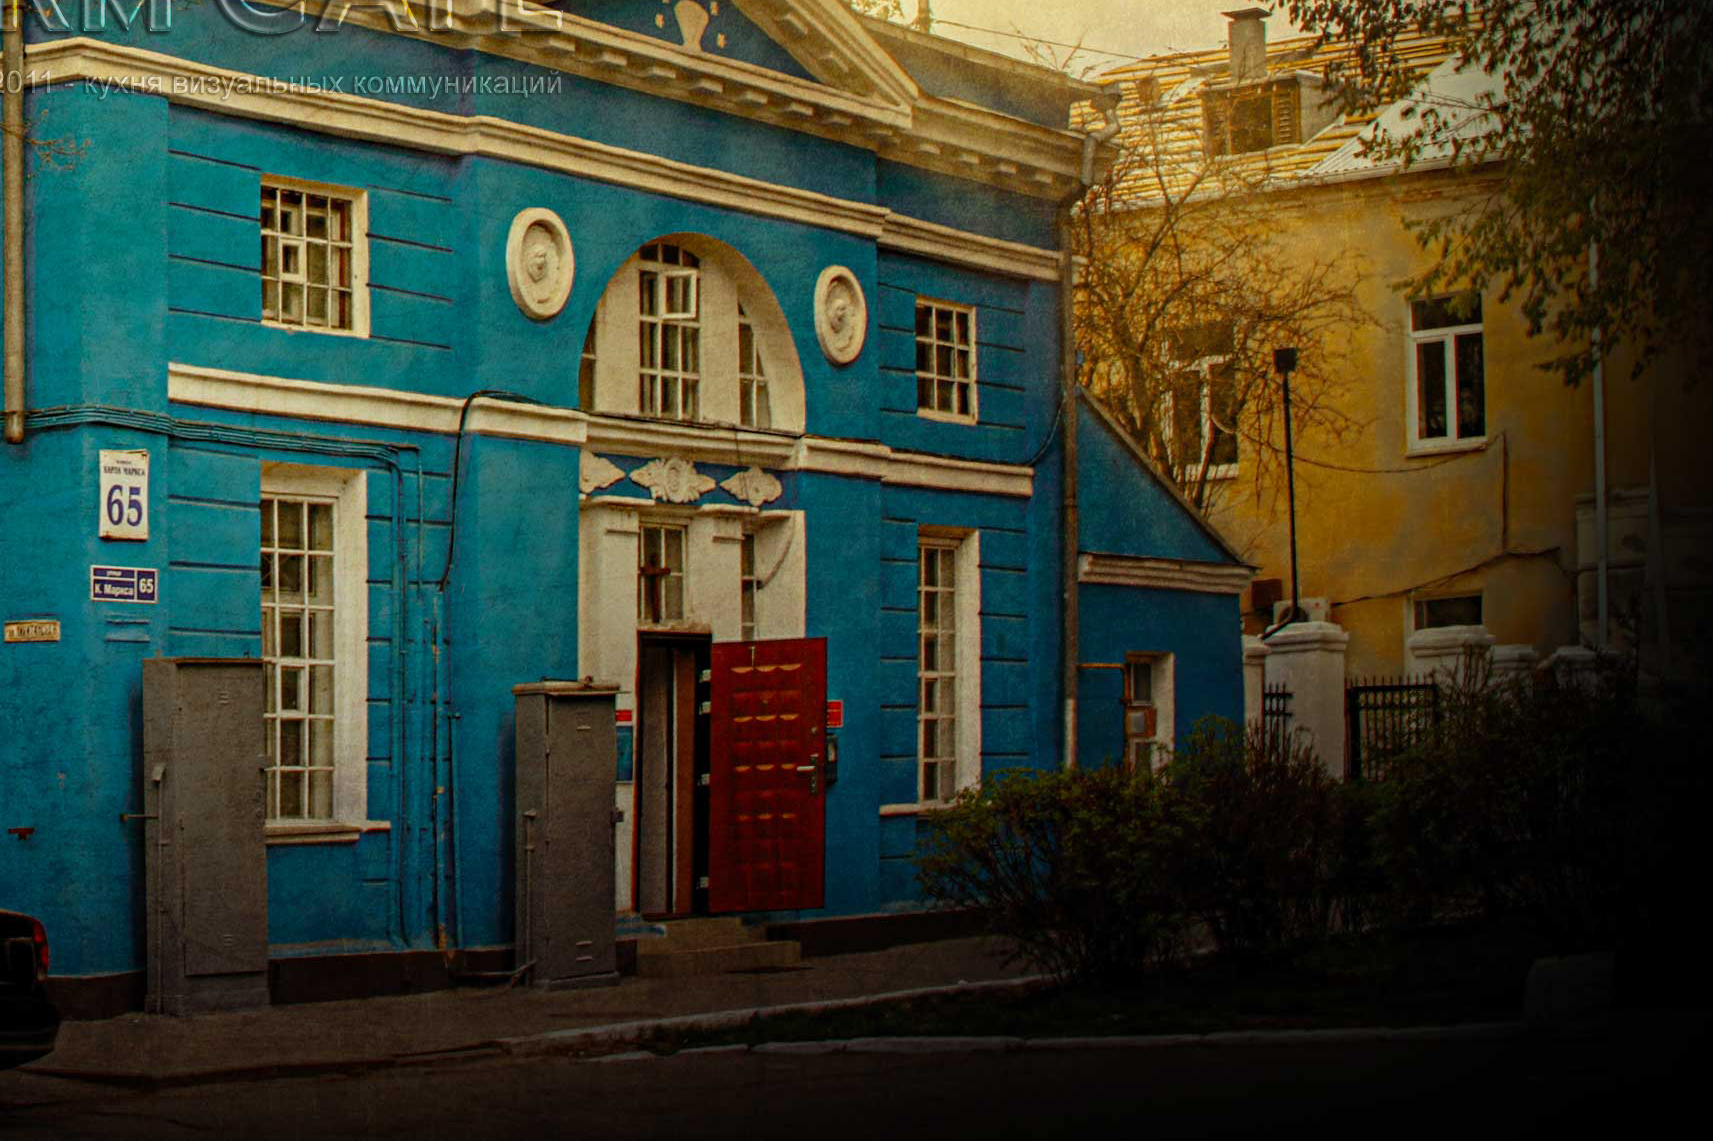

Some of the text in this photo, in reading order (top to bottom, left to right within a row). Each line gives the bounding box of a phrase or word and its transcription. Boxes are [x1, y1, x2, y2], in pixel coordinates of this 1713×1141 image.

[107, 484, 143, 527] 65
[104, 584, 134, 597] Маркса
[139, 578, 154, 594] 65
